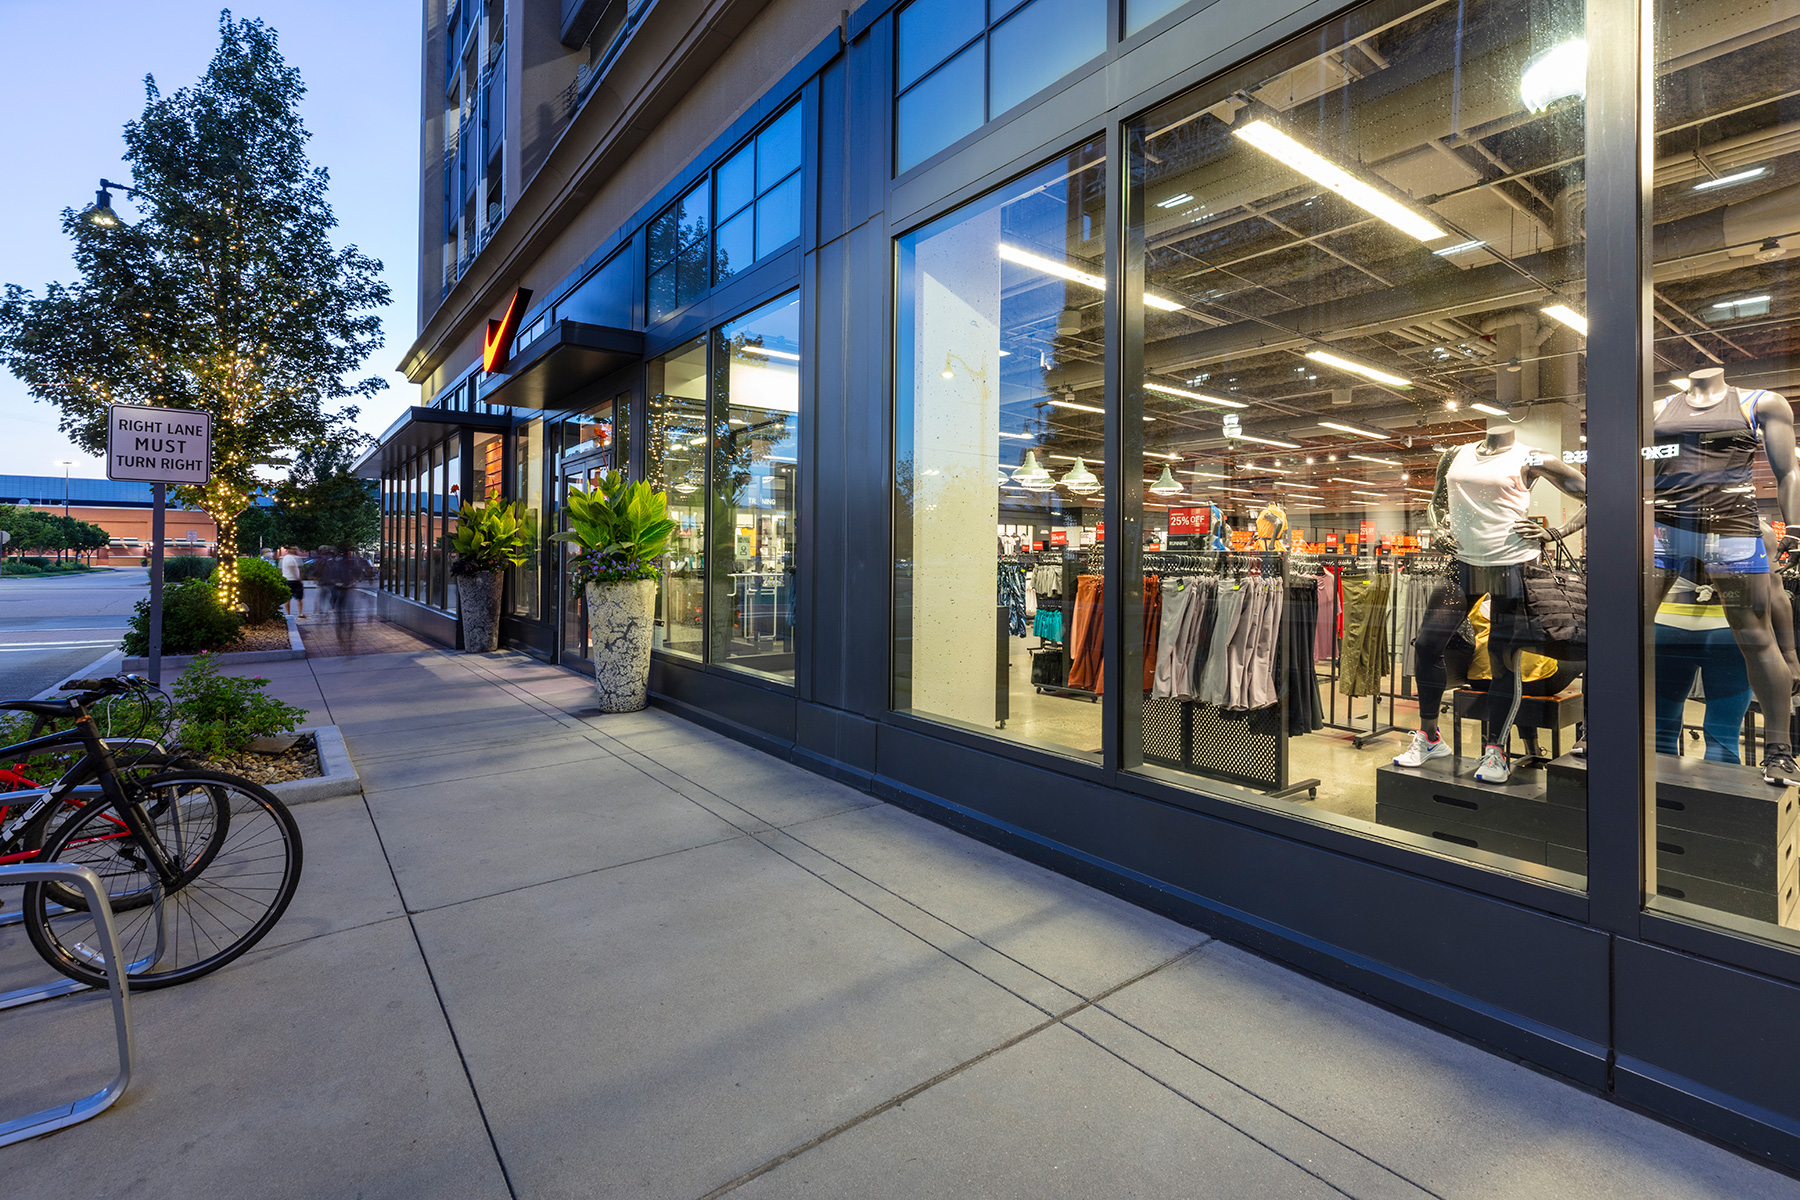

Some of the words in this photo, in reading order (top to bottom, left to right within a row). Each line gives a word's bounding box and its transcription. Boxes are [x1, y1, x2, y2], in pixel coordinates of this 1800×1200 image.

[119, 419, 162, 433] RIGHT
[168, 423, 203, 437] LANE
[135, 437, 187, 454] MUST
[116, 455, 156, 469] TURN
[161, 458, 203, 471] RIGHT
[748, 497, 776, 505] TRNING
[1170, 516, 1190, 526] 25%
[1190, 515, 1205, 523] OFF
[0, 783, 68, 842] REK
